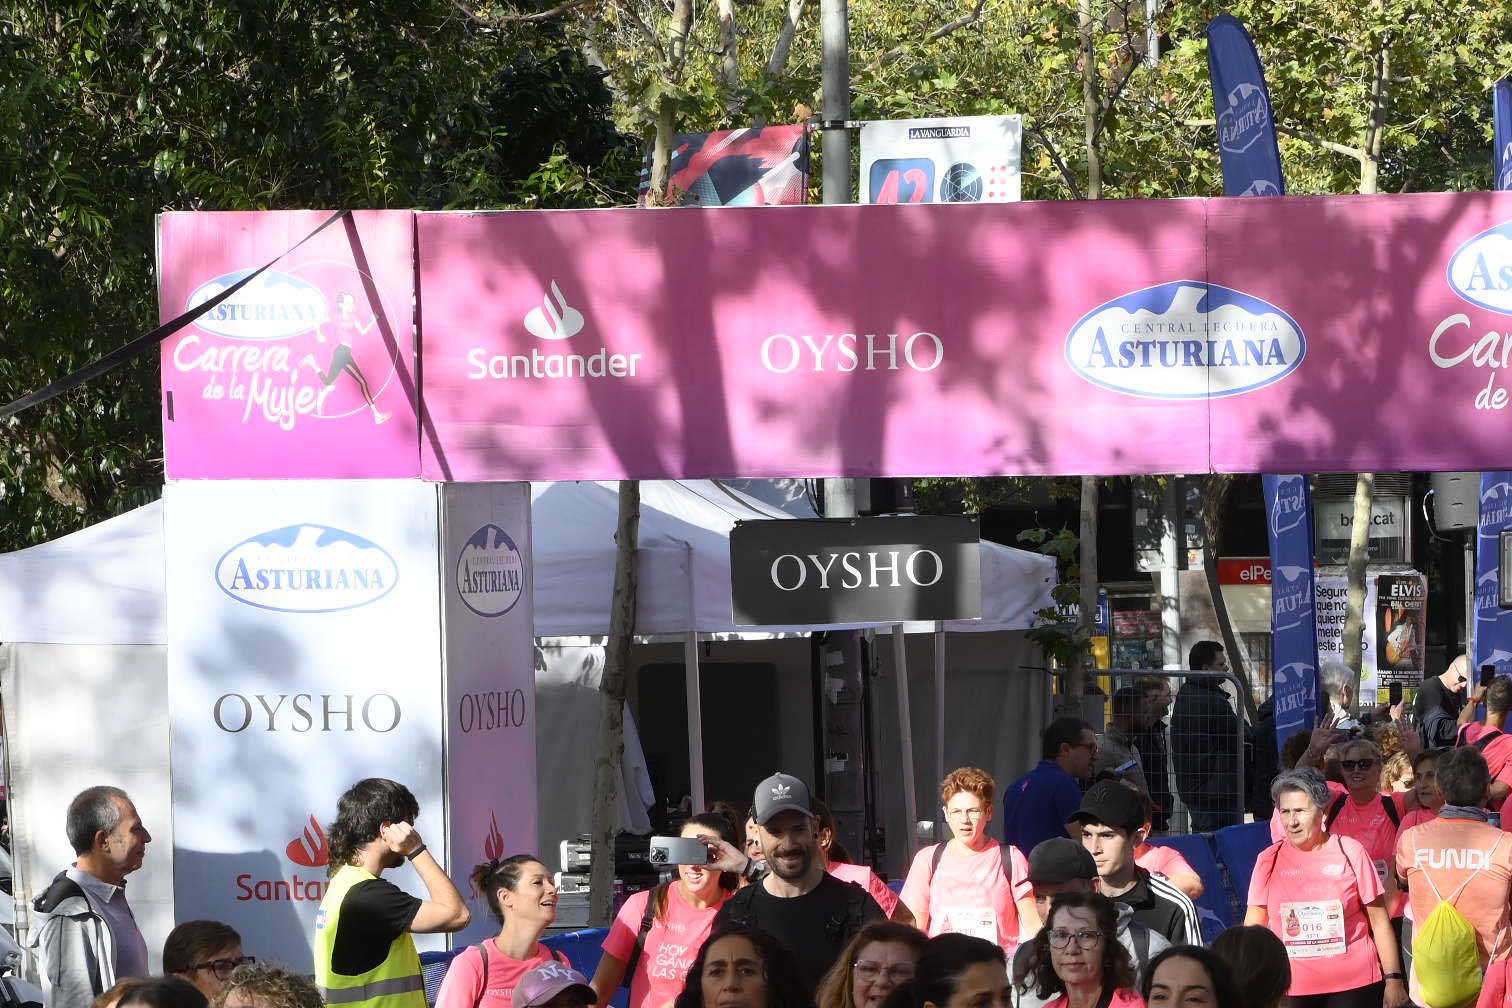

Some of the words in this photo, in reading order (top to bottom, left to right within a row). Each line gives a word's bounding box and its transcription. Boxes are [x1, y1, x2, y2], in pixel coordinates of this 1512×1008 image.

[1121, 322, 1197, 334] CENTRAL
[1203, 320, 1279, 333] LECHERA
[174, 335, 291, 372] Carrera
[468, 348, 641, 380] Santander
[760, 332, 944, 373] OYSHO
[1086, 326, 1288, 369] ASTURIANA
[203, 376, 223, 400] de
[230, 370, 243, 400] la
[242, 370, 336, 432] Mujer
[1474, 372, 1509, 411] de
[230, 557, 385, 590] ASTURIANA
[461, 558, 520, 594] ASTURIANA
[771, 550, 943, 591] OYSHO
[1391, 585, 1421, 598] ELVIS
[1319, 642, 1336, 651] este
[213, 693, 402, 733] OYSHO
[459, 688, 526, 733] OYSHO
[1302, 923, 1322, 932] 016
[652, 966, 676, 980] LAS
